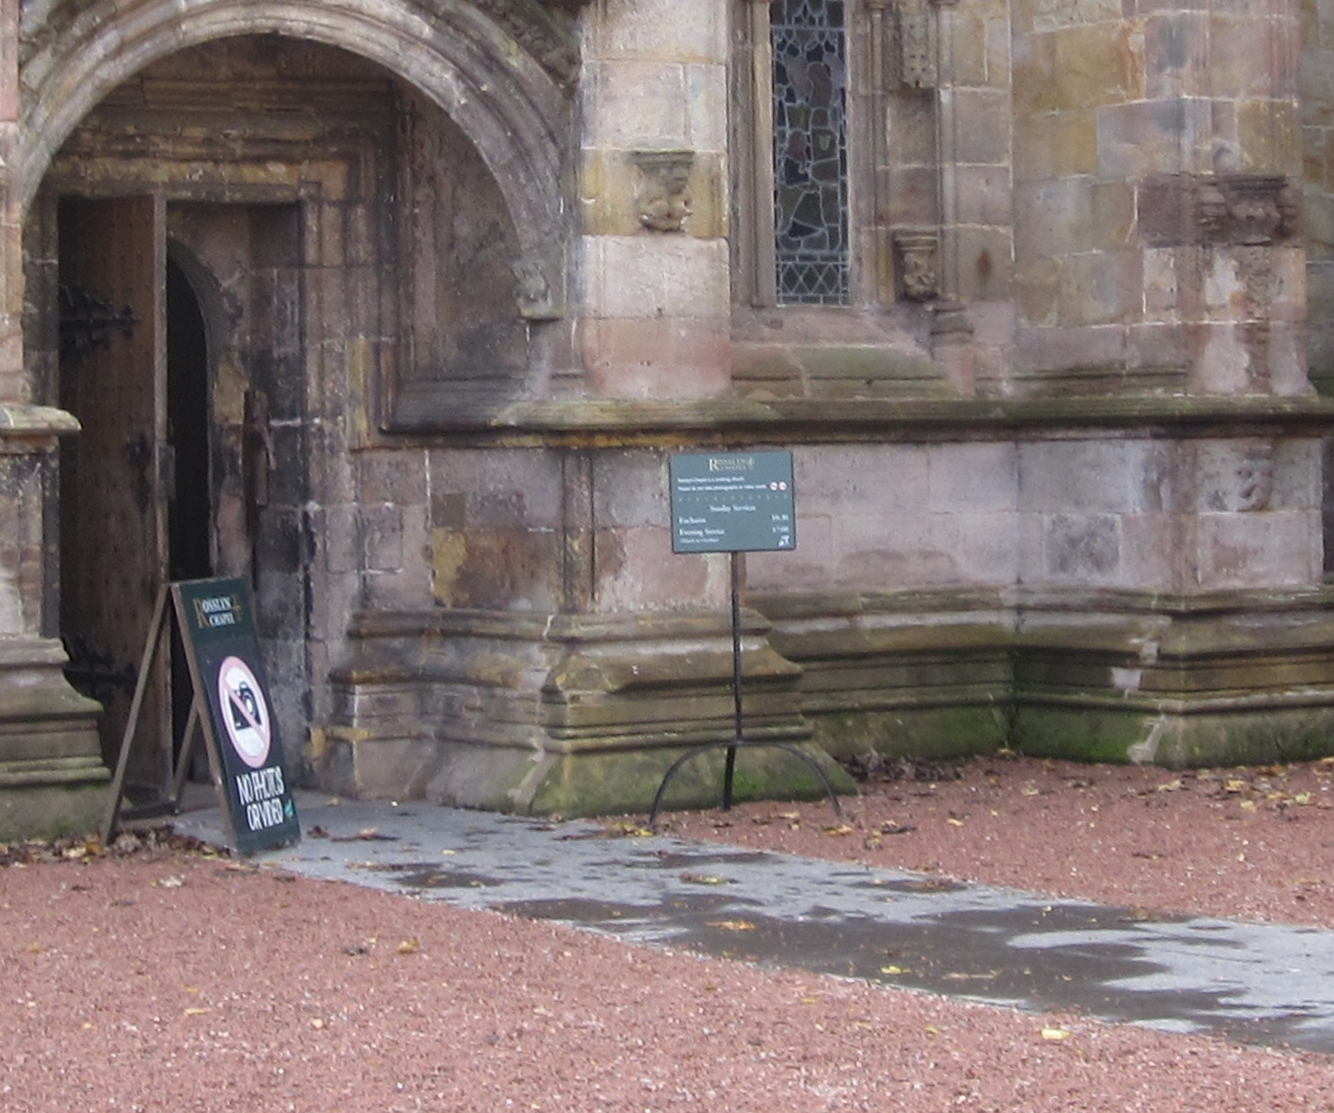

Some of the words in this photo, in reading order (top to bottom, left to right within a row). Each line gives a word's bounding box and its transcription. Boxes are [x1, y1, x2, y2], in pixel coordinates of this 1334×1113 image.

[235, 773, 254, 806] NO
[250, 765, 285, 801] PHOTOS
[246, 802, 264, 832] OR
[257, 797, 284, 828] VIDEO
